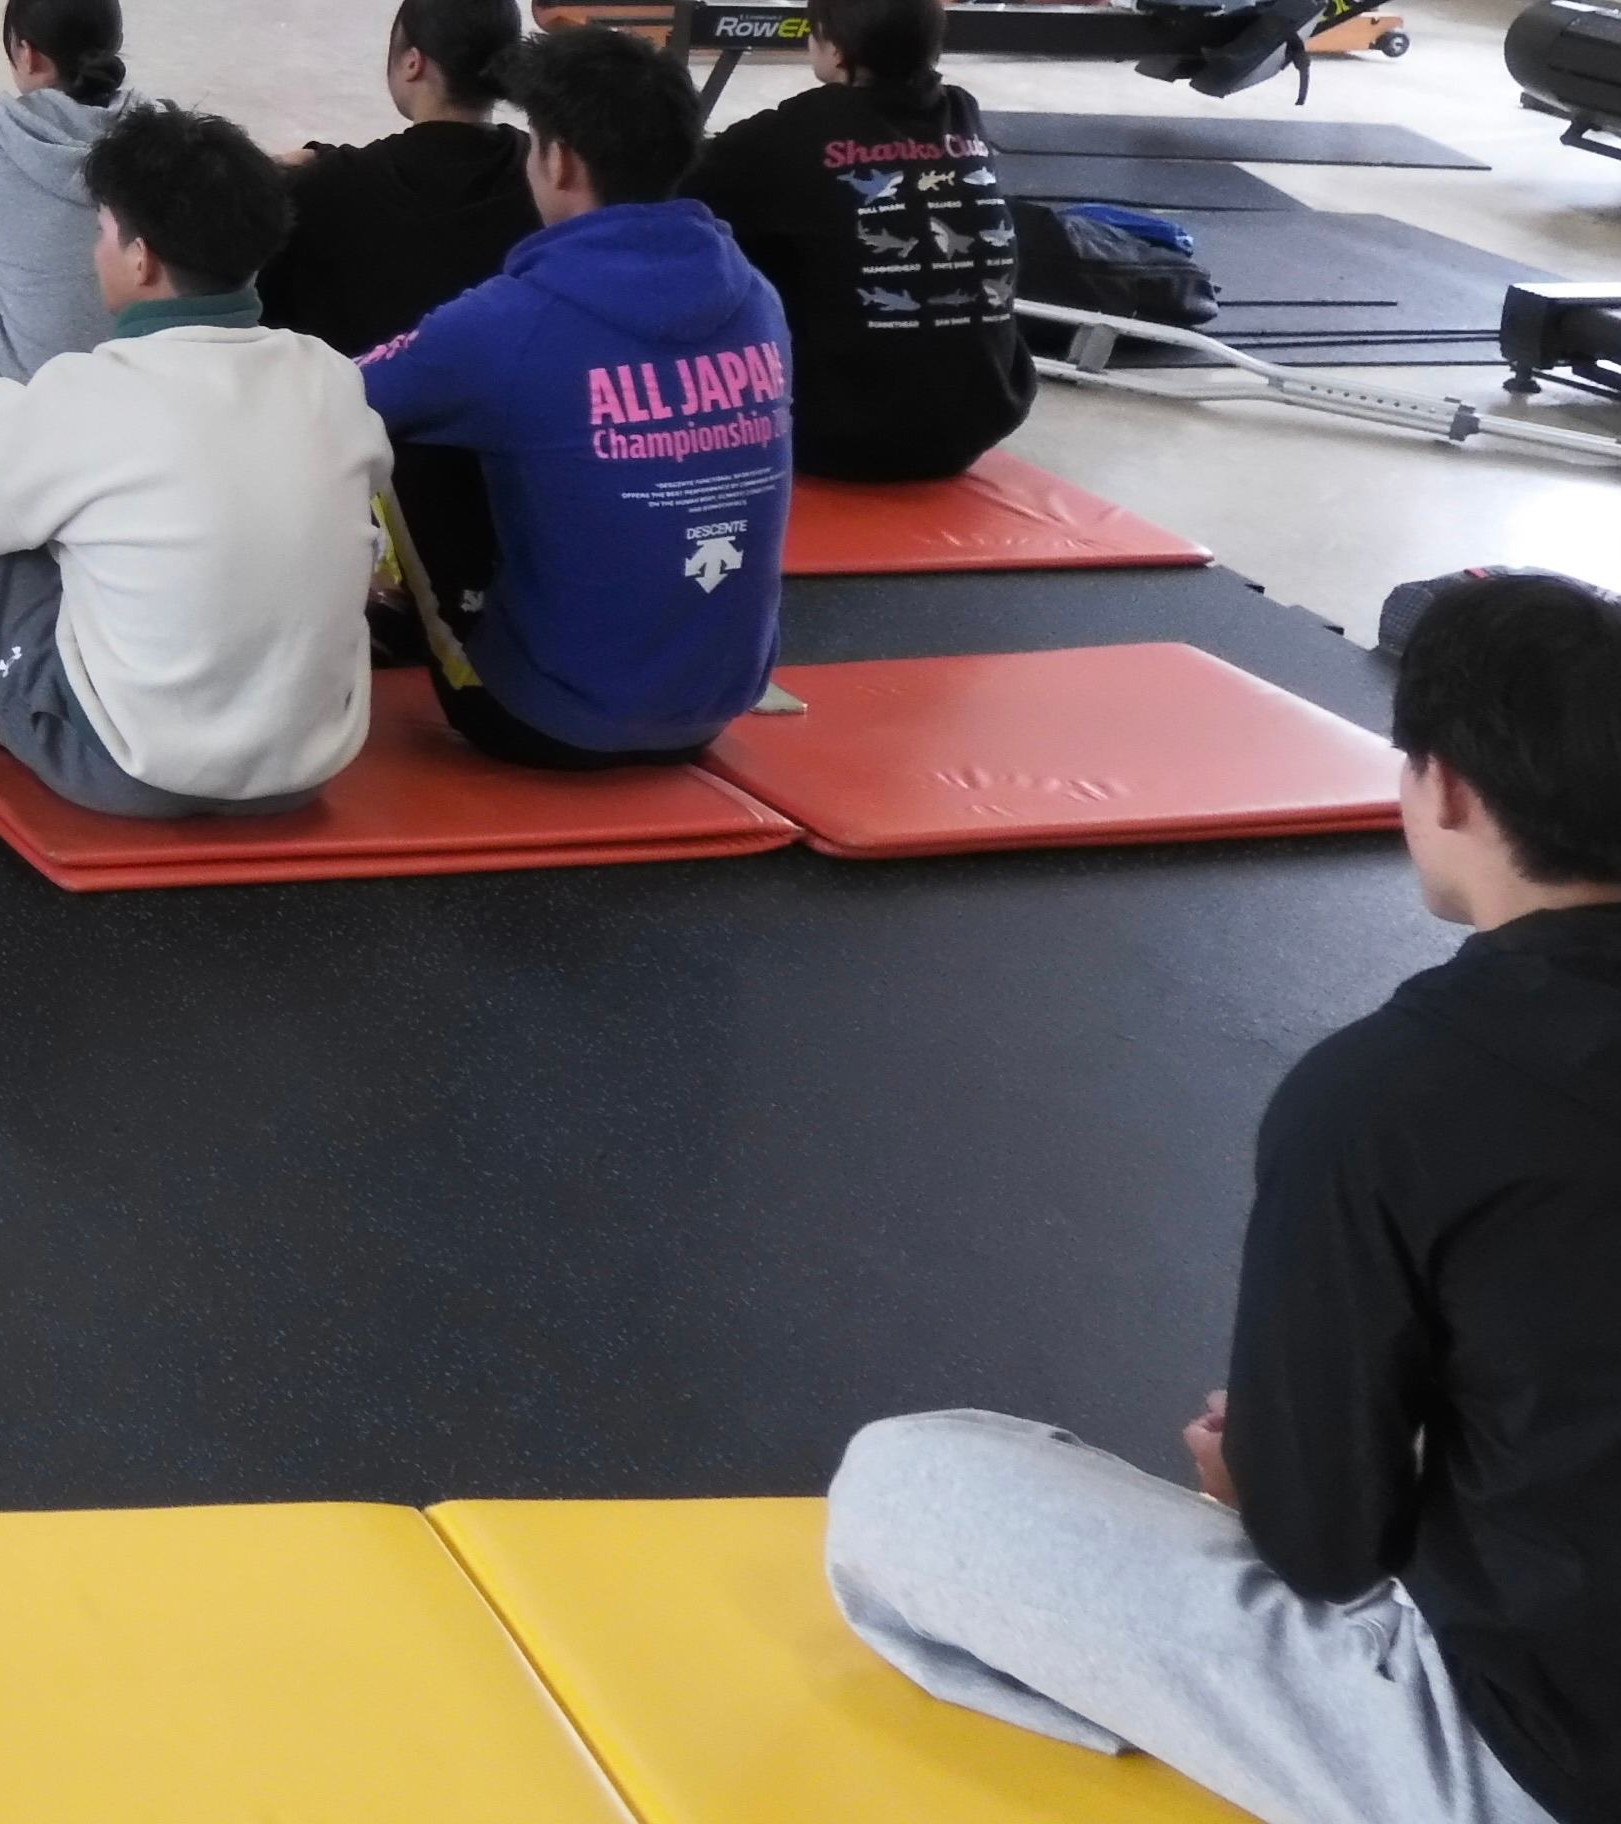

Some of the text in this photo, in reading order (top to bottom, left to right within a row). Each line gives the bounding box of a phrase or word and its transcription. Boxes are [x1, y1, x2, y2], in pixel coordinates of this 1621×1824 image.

[823, 138, 945, 168] Sharks
[588, 340, 785, 426] ALL JAPAN
[592, 410, 773, 463] Championship
[685, 519, 749, 540] DESCENTE
